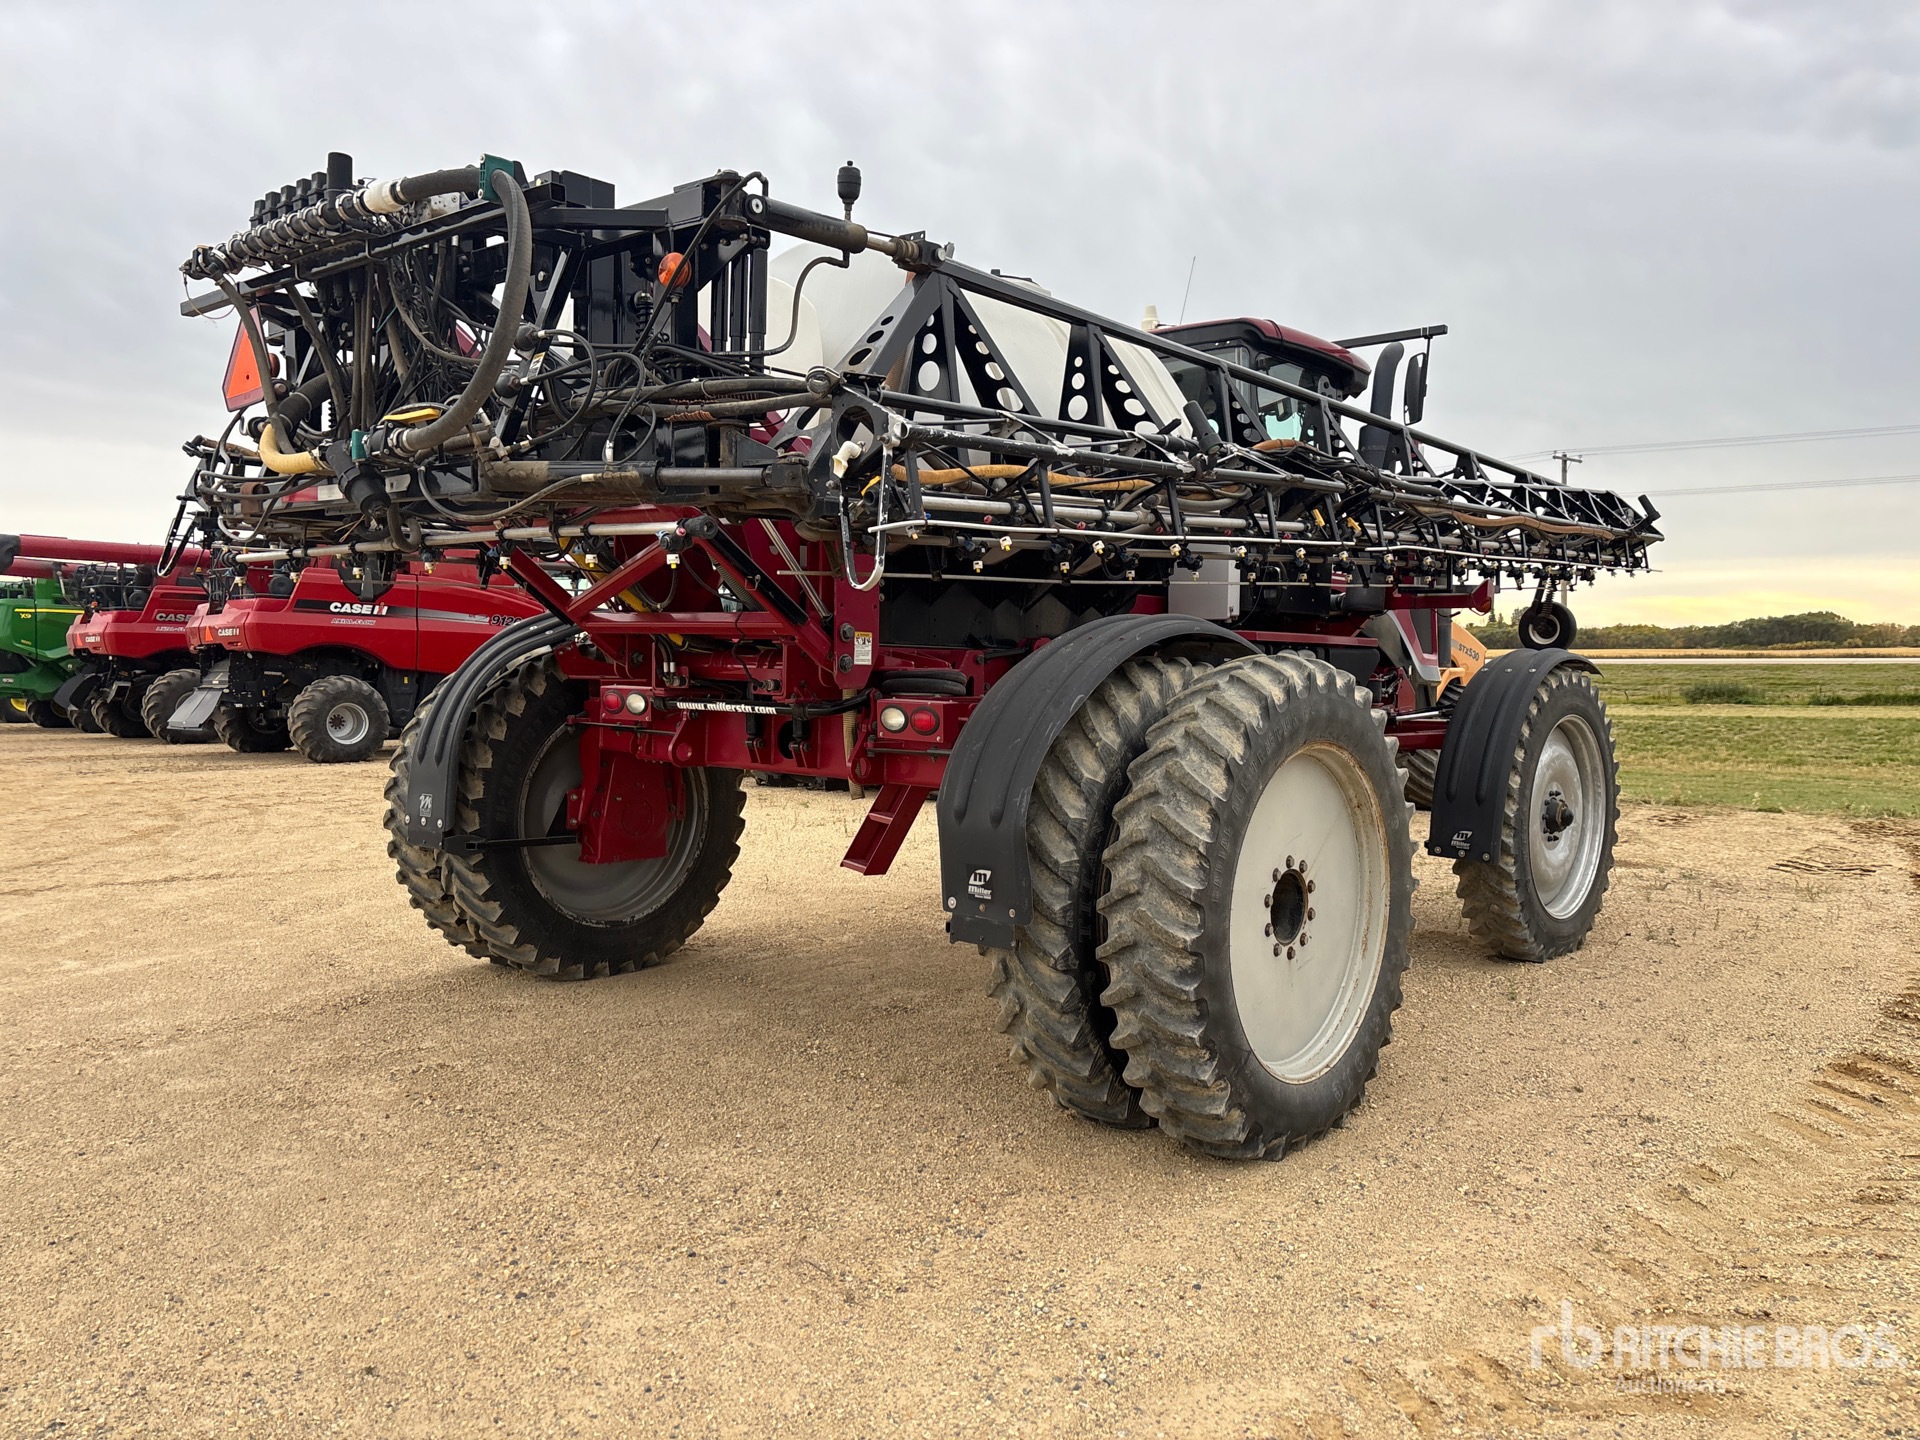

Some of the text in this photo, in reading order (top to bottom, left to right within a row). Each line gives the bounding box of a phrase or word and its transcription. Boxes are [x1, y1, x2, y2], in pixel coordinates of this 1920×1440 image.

[329, 602, 373, 614] CASE
[218, 628, 233, 637] CASE
[1458, 643, 1480, 661] STX530
[676, 701, 778, 715] www.millerstn.com
